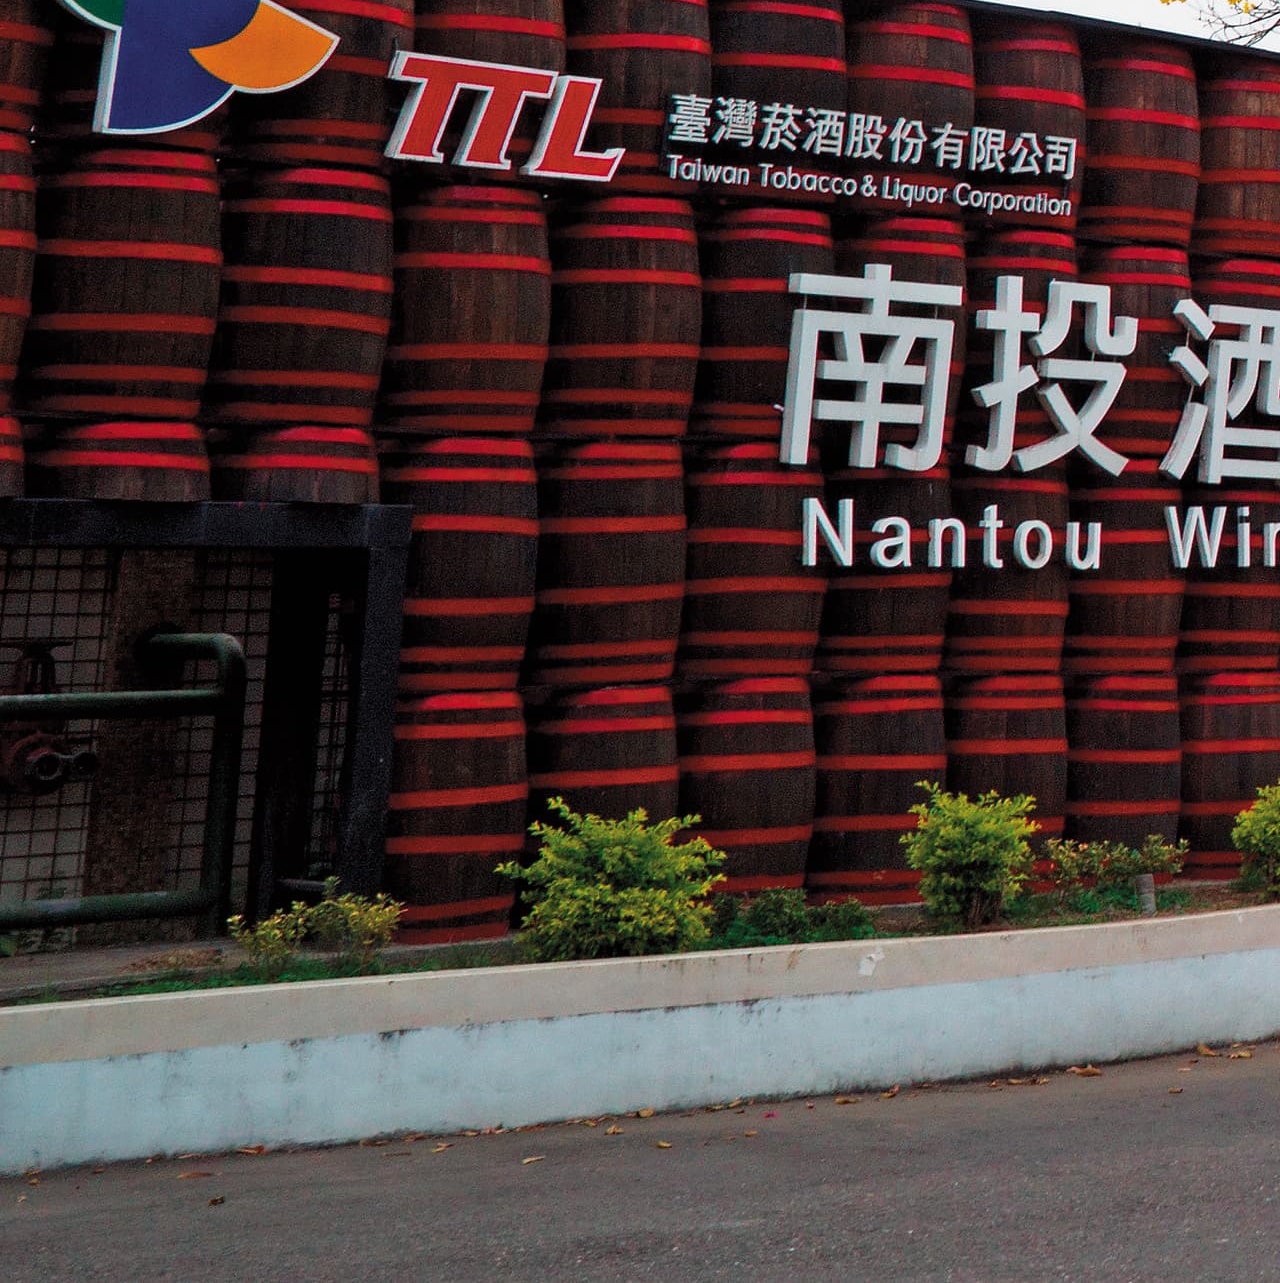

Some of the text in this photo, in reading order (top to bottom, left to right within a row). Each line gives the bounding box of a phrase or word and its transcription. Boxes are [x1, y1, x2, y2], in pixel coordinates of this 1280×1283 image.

[384, 50, 626, 182] TTL
[667, 93, 1078, 181] 臺灣菸酒股份有限公司
[666, 154, 1072, 217] Taiwan Tobacco & Liquor Corporation
[802, 497, 1101, 570] Nantou
